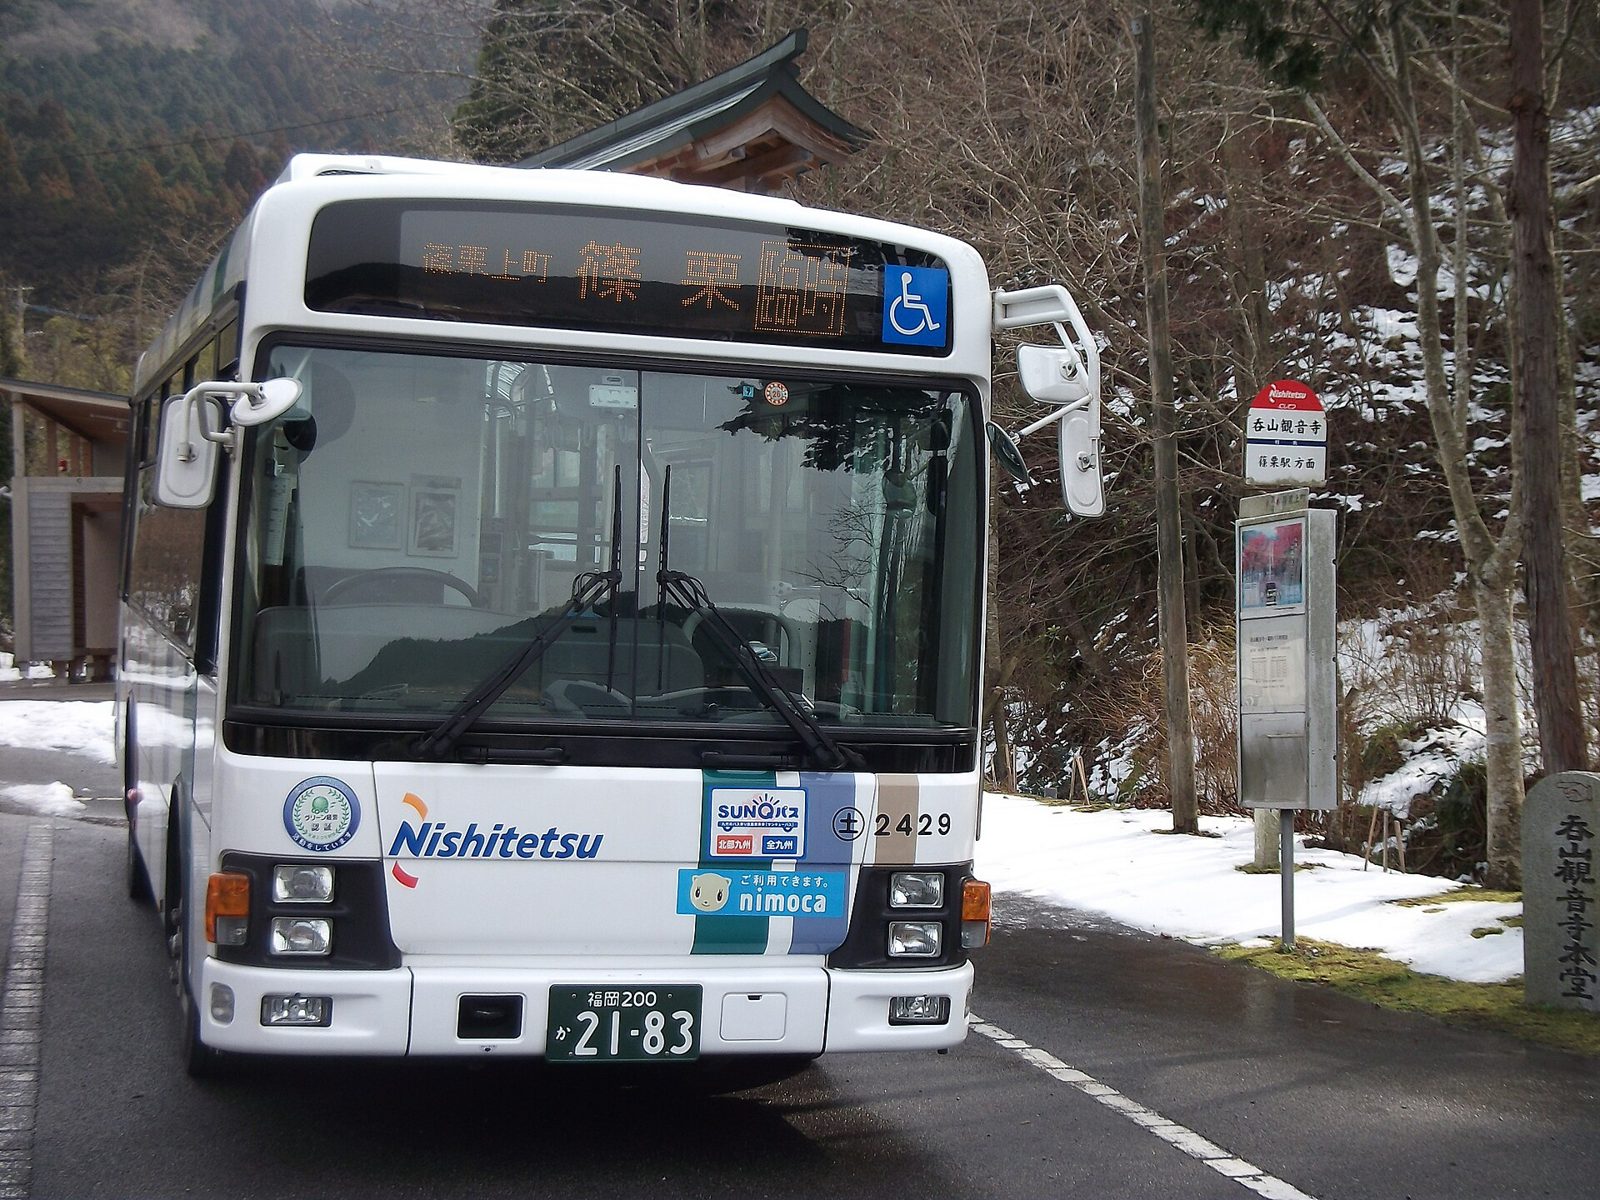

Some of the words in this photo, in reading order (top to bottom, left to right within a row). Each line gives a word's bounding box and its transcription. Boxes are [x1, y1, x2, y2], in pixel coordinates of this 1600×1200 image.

[1252, 417, 1322, 435] 呑山観音寺
[873, 813, 951, 837] 2429
[389, 820, 605, 860] Nishitetsu
[718, 839, 751, 850] 北部九州
[766, 839, 793, 850] 全九州
[739, 887, 827, 913] nimoca
[1554, 814, 1597, 1000] 呑山観音寺本堂
[555, 1025, 572, 1041] か
[573, 1010, 695, 1056] 21-83
